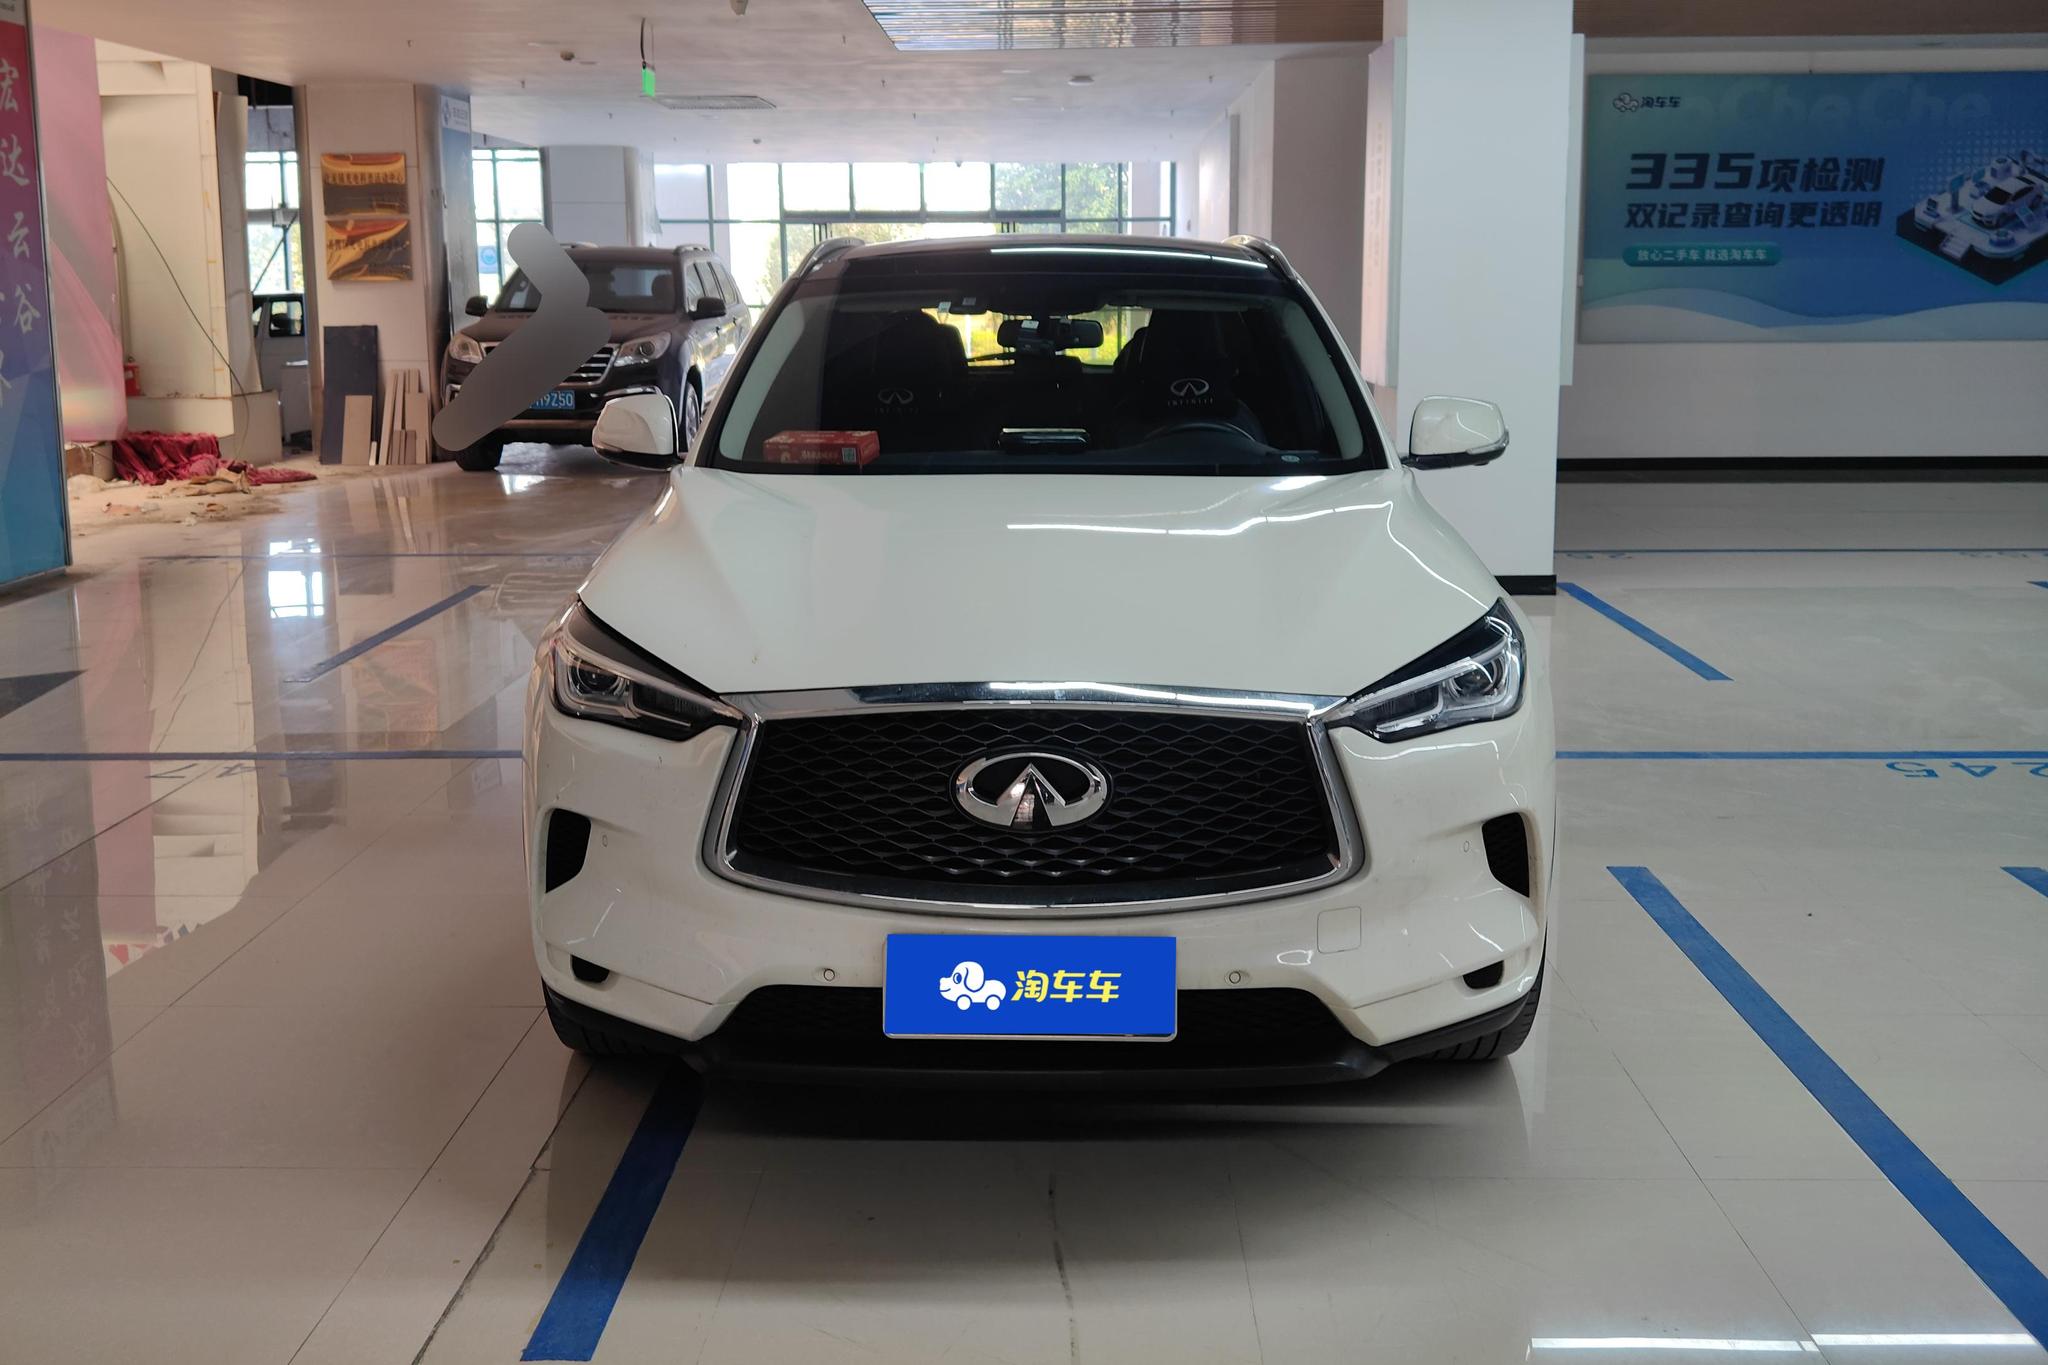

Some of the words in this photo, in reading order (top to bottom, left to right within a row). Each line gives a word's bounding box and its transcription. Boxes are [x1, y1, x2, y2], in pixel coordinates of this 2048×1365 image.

[1640, 96, 1681, 109] 淘车车
[1625, 152, 1886, 194] 335项检测
[1624, 201, 1883, 230] 双记录查询更透明
